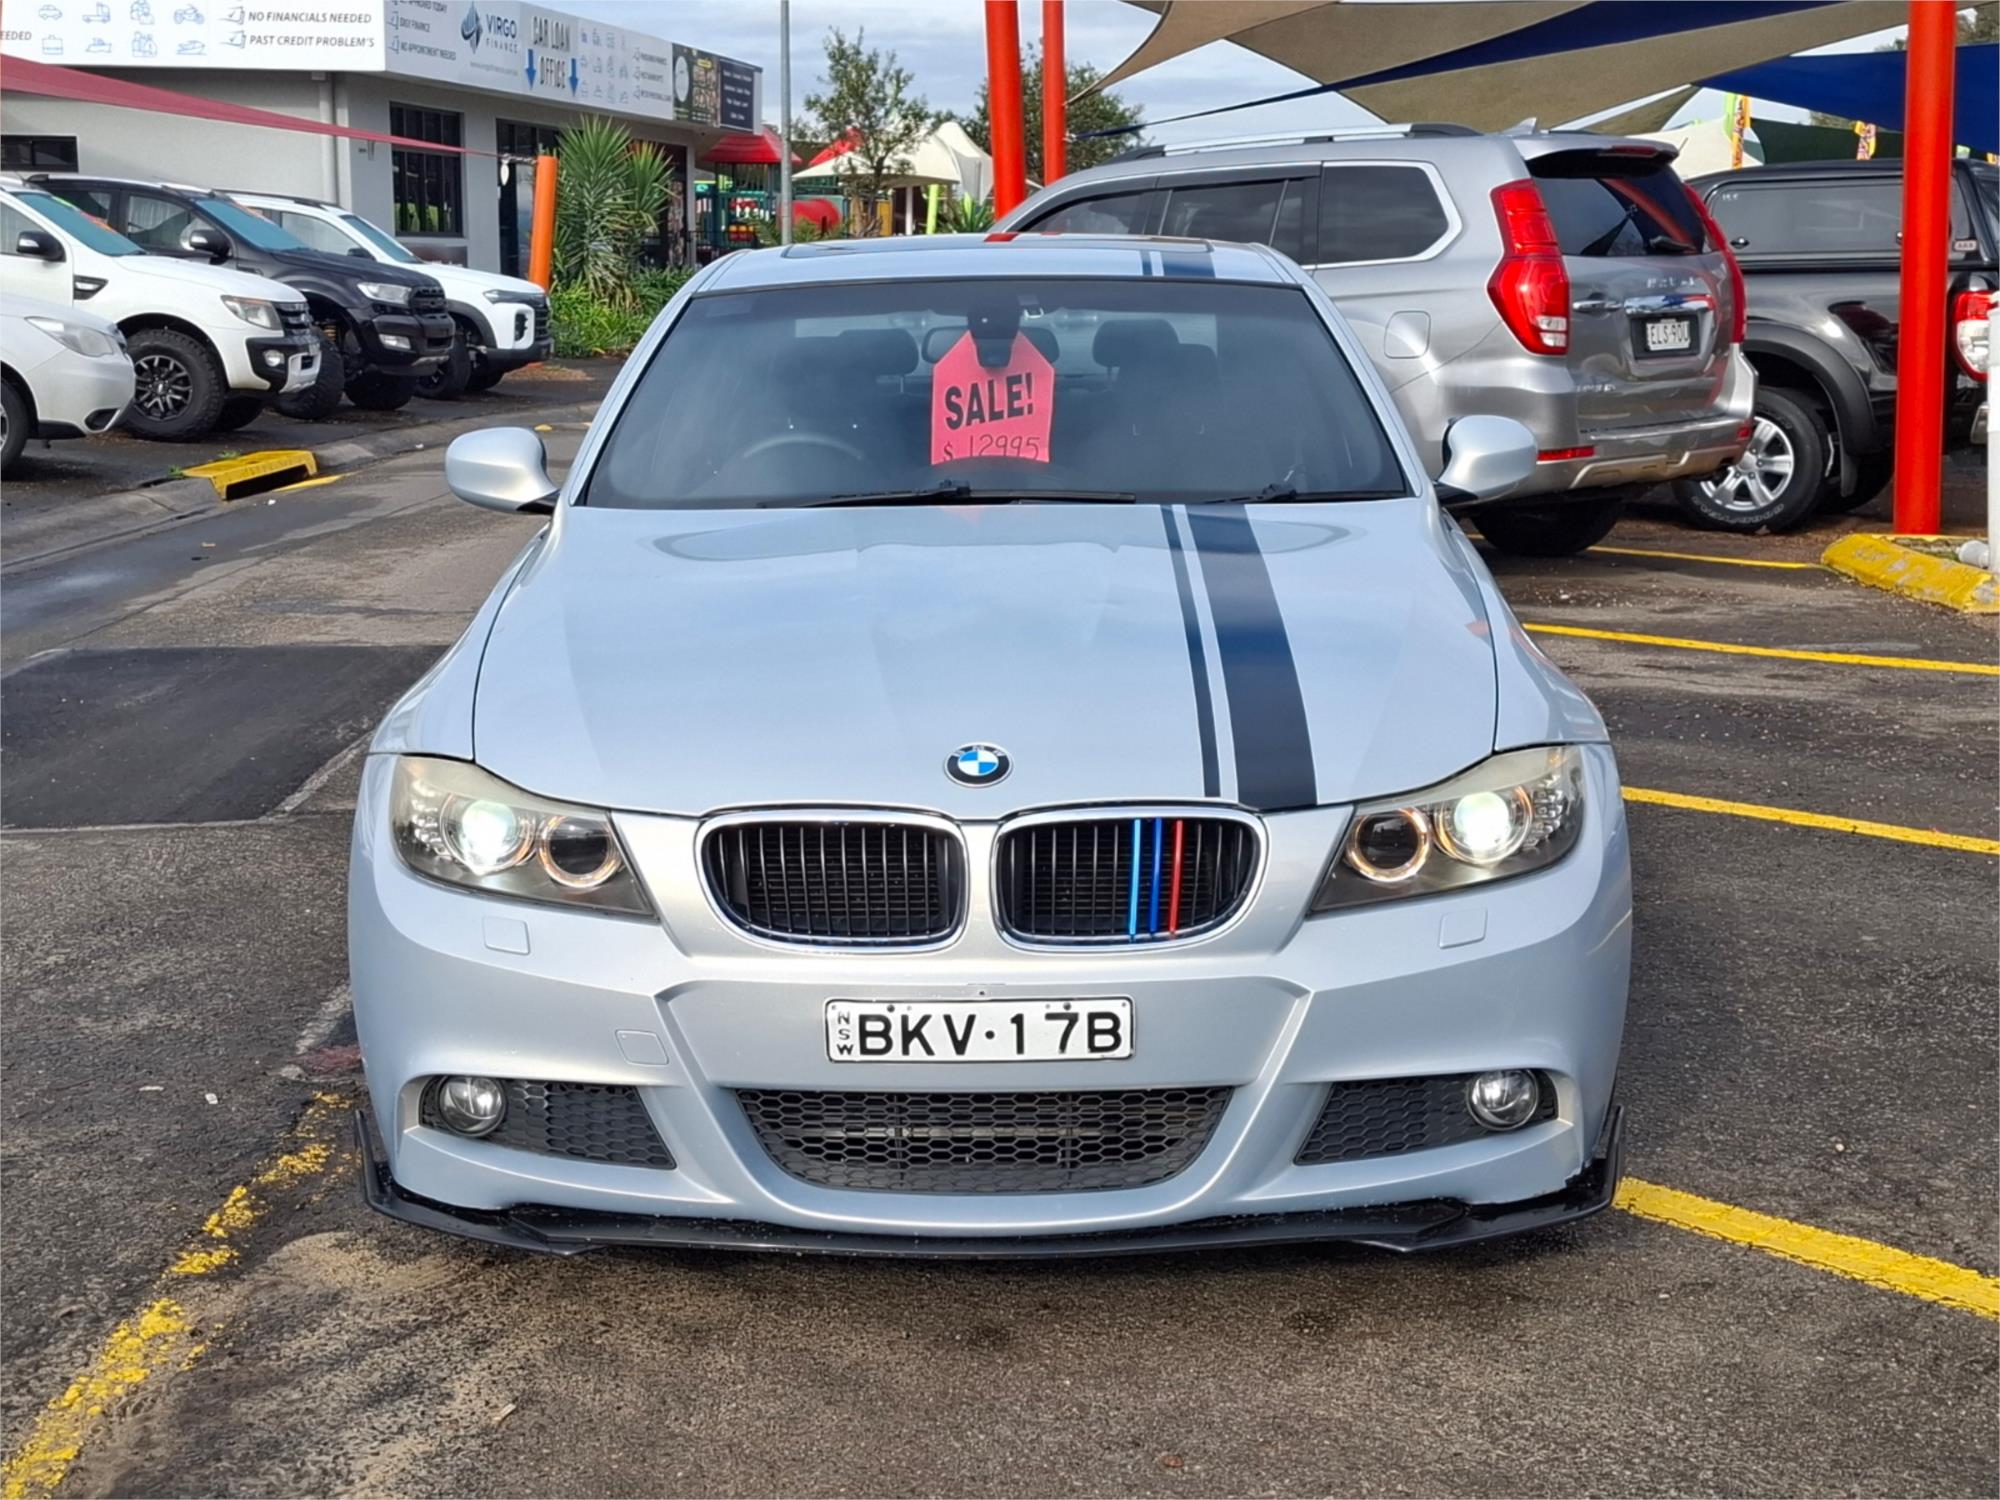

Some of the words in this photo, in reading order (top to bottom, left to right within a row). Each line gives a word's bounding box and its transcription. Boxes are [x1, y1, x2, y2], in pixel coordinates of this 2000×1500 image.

[249, 12, 264, 21] NO
[267, 12, 326, 22] FINANCIALS
[329, 13, 372, 23] NEEDED
[486, 14, 517, 39] VIRGO
[250, 35, 274, 45] PAST
[277, 36, 314, 46] CREDIT
[316, 37, 374, 48] PROBLEM'S
[486, 37, 518, 54] FINANCE
[533, 16, 549, 48] CAR
[551, 20, 570, 52] LOAN
[540, 56, 565, 89] OFFICE
[945, 372, 1033, 430] SALE!
[970, 434, 1040, 461] 12995
